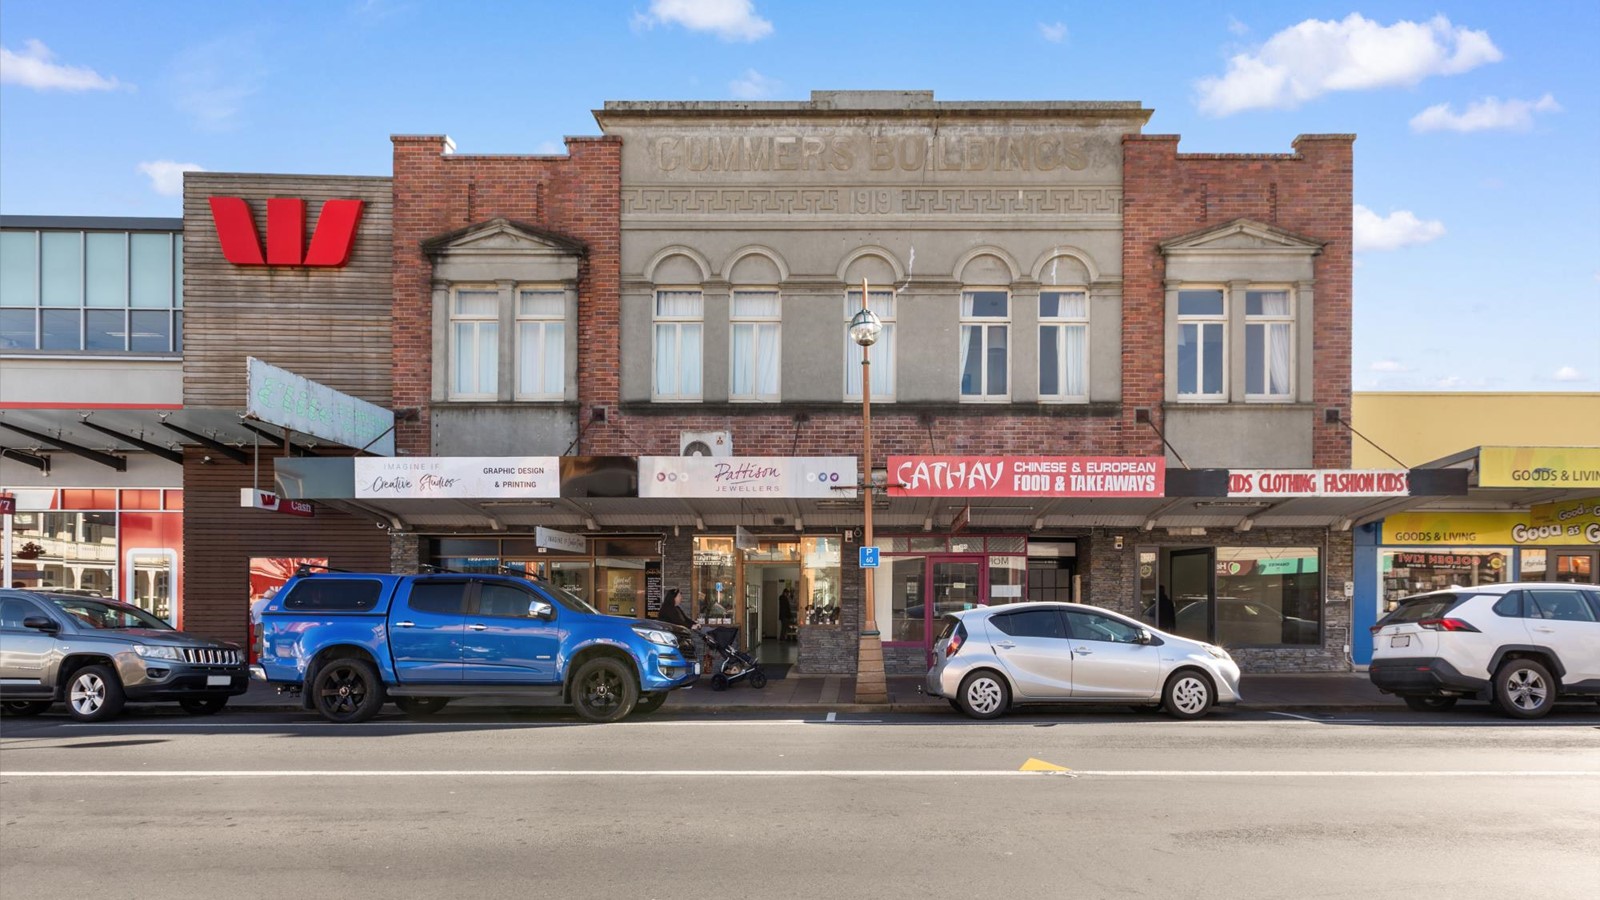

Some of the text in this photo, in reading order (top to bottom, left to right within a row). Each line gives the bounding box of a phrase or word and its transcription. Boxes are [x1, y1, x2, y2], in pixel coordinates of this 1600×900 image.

[868, 134, 1090, 172] BUILDINGS
[850, 189, 890, 214] 1919
[383, 463, 441, 471] IMAGINE IF
[482, 467, 545, 475] GRAPHIC DESIGN
[714, 462, 781, 482] Pattison
[1014, 462, 1156, 473] CHINESE & EUROPEAN
[897, 459, 1004, 490] CATHAY
[1512, 469, 1558, 481] GOODS
[1560, 470, 1570, 481] &
[363, 473, 462, 493] Creative Studios
[1013, 474, 1155, 491] FOOD & TAKEAWAYS
[1258, 473, 1316, 493] CLOTHING
[1324, 473, 1375, 492] FASHION
[1376, 473, 1405, 492] KIDS
[291, 501, 312, 512] Cash
[1395, 532, 1477, 542] GOODS & LIVING
[1567, 525, 1580, 537] as
[866, 548, 873, 556] P
